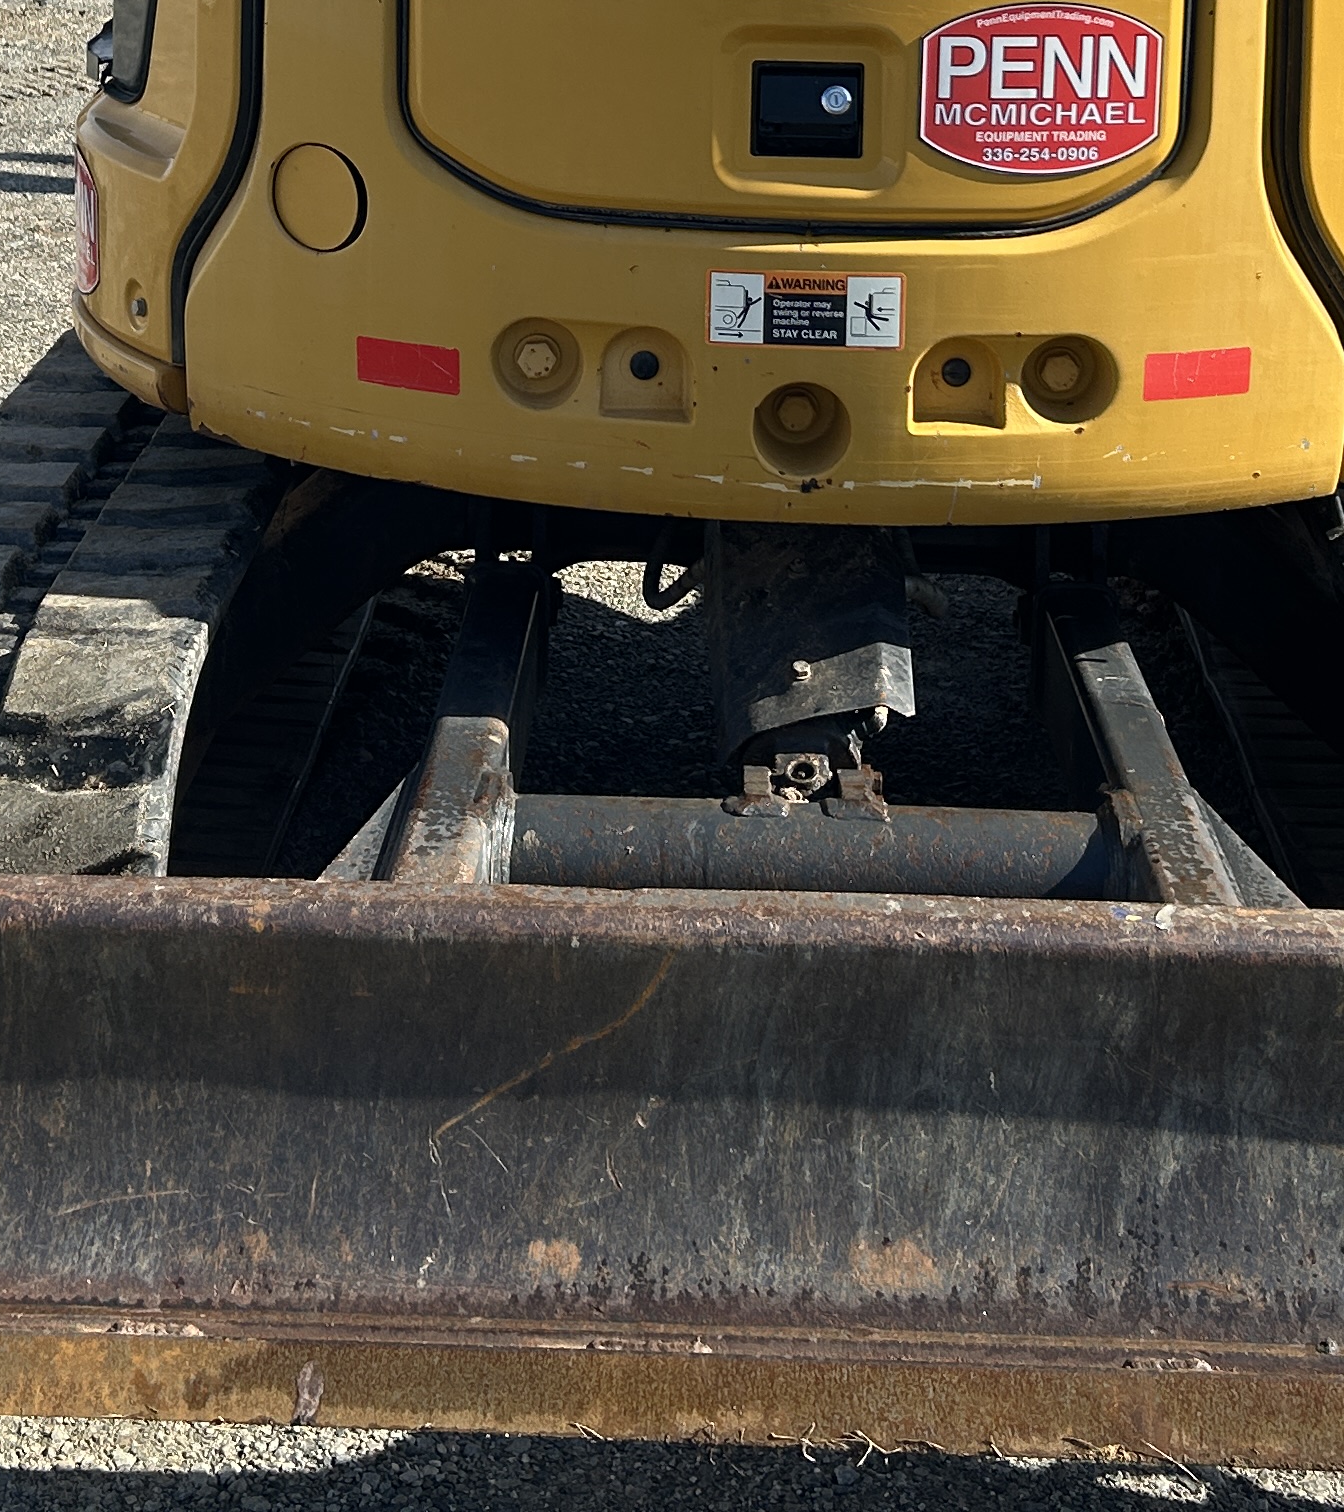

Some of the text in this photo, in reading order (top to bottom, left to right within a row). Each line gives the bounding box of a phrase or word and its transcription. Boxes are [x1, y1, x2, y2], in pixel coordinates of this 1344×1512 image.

[976, 10, 1115, 28] PennEquipmentTrading.com
[937, 35, 1148, 99] PENN
[934, 101, 1147, 127] MCMICHAEL
[975, 130, 1107, 143] EQUIPMENT TRADING
[982, 146, 1099, 163] 336-254-0906
[781, 278, 845, 291] WARNING
[773, 299, 832, 309] Operator may
[773, 309, 799, 319] swing
[812, 310, 845, 318] reverse
[772, 318, 810, 327] machine
[772, 328, 838, 340] STAY CLEAR
